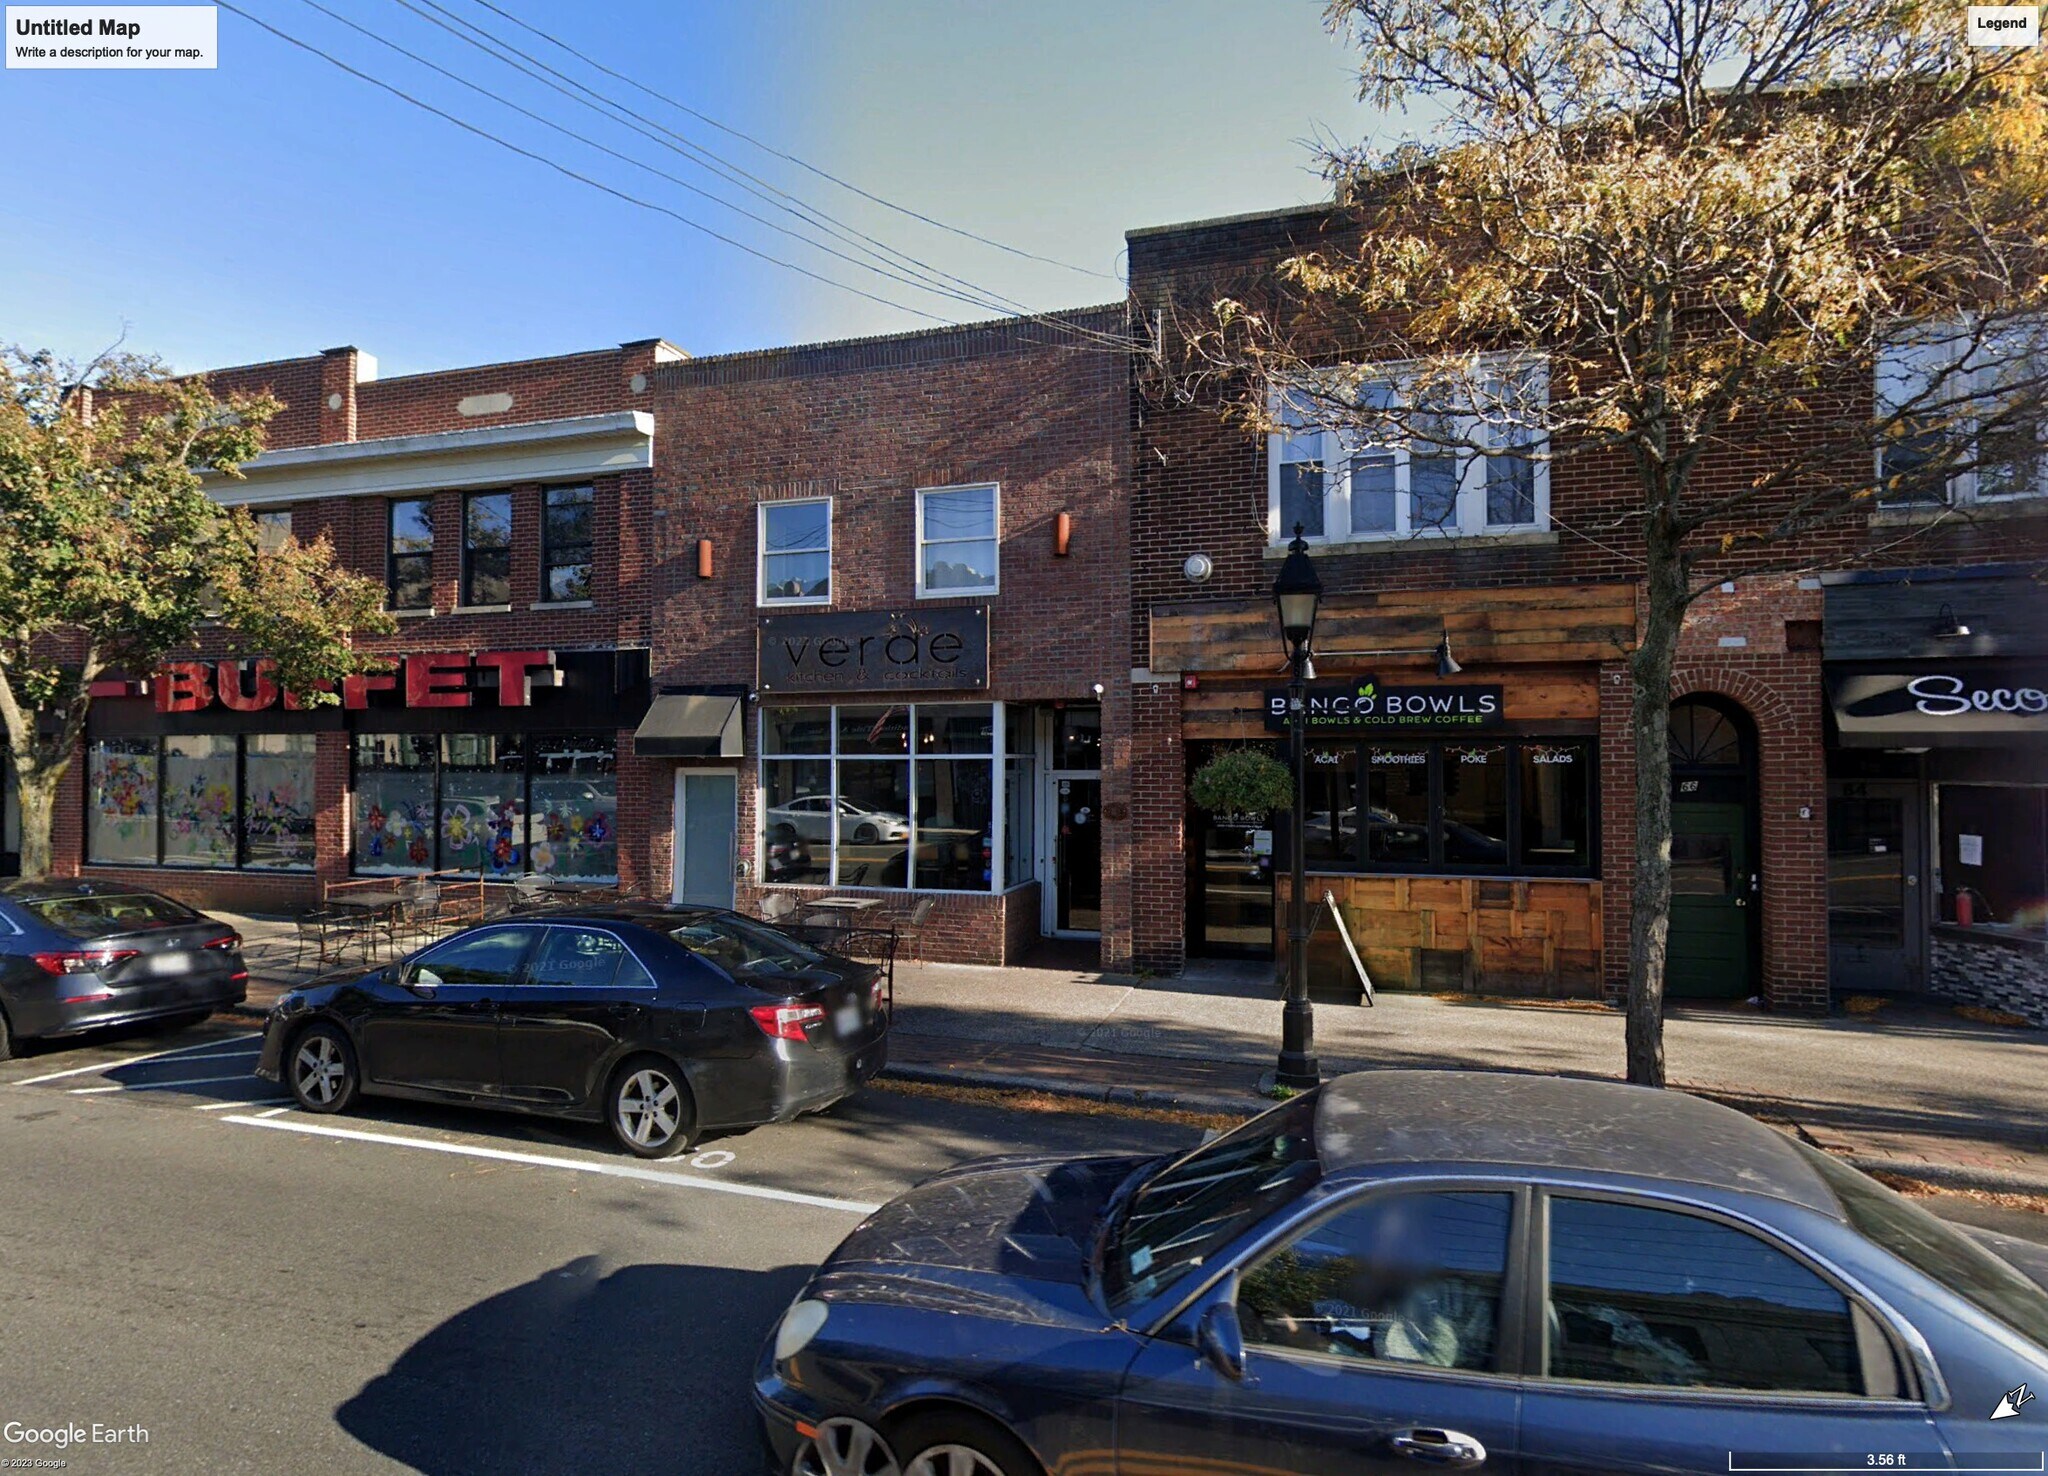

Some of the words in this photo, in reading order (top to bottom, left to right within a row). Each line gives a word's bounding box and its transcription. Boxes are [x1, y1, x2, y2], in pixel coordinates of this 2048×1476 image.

[784, 630, 963, 667] verde
[786, 670, 844, 683] kitchen
[855, 668, 870, 681] &
[883, 667, 968, 682] cocktails
[154, 650, 556, 712] BUFET
[1271, 697, 1374, 715] BNGO
[1386, 695, 1496, 714] BOWLS
[1282, 717, 1308, 725] AI
[1311, 716, 1350, 725] BOWLS
[1353, 716, 1361, 724] &
[1364, 715, 1396, 724] COLD
[1399, 715, 1431, 724] BREW
[1434, 714, 1483, 724] COFFEE
[1371, 755, 1426, 765] SMOOTHIES
[1460, 754, 1487, 764] POKE
[1532, 755, 1573, 764] SALADS
[1681, 781, 1698, 792] 66
